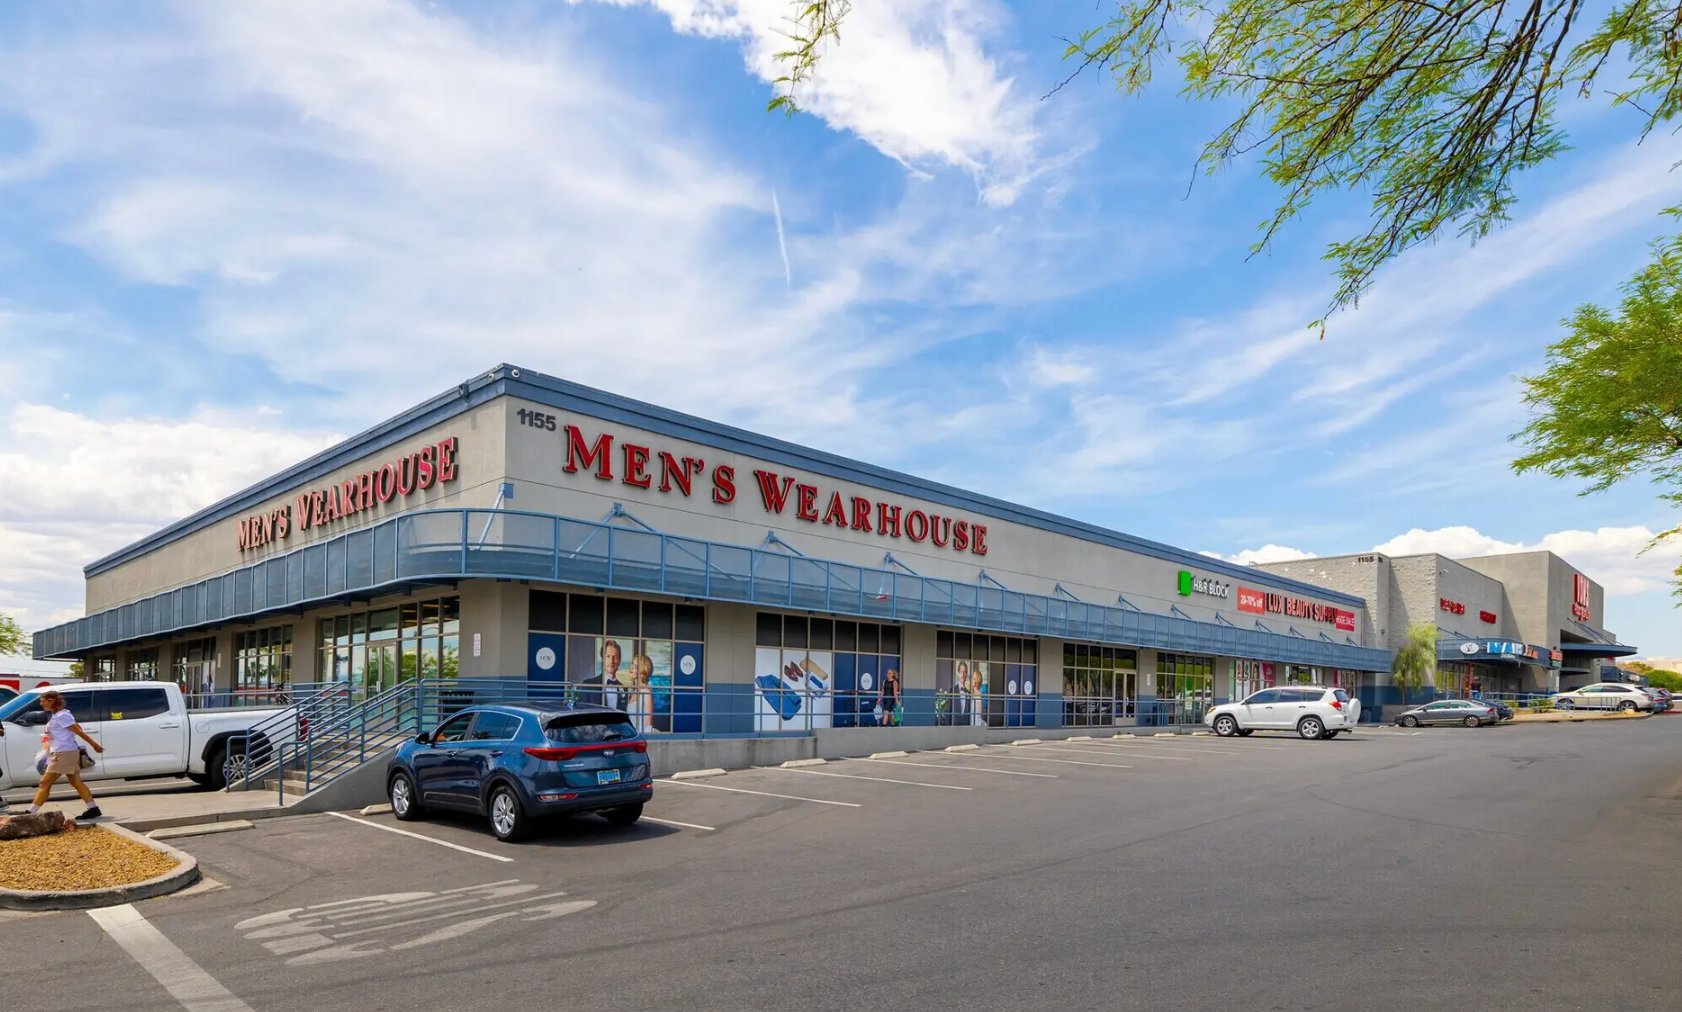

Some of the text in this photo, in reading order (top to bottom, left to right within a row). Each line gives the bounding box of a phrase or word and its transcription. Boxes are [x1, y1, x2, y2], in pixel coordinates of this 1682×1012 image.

[516, 408, 557, 432] 1155
[236, 436, 459, 551] MEN'S WEARHOUSE
[563, 424, 989, 556] MEN'S WEARHOUSE
[1193, 580, 1230, 598] H&R BLOCK
[1266, 593, 1282, 613] LUX
[1284, 597, 1313, 619] BEAUTY
